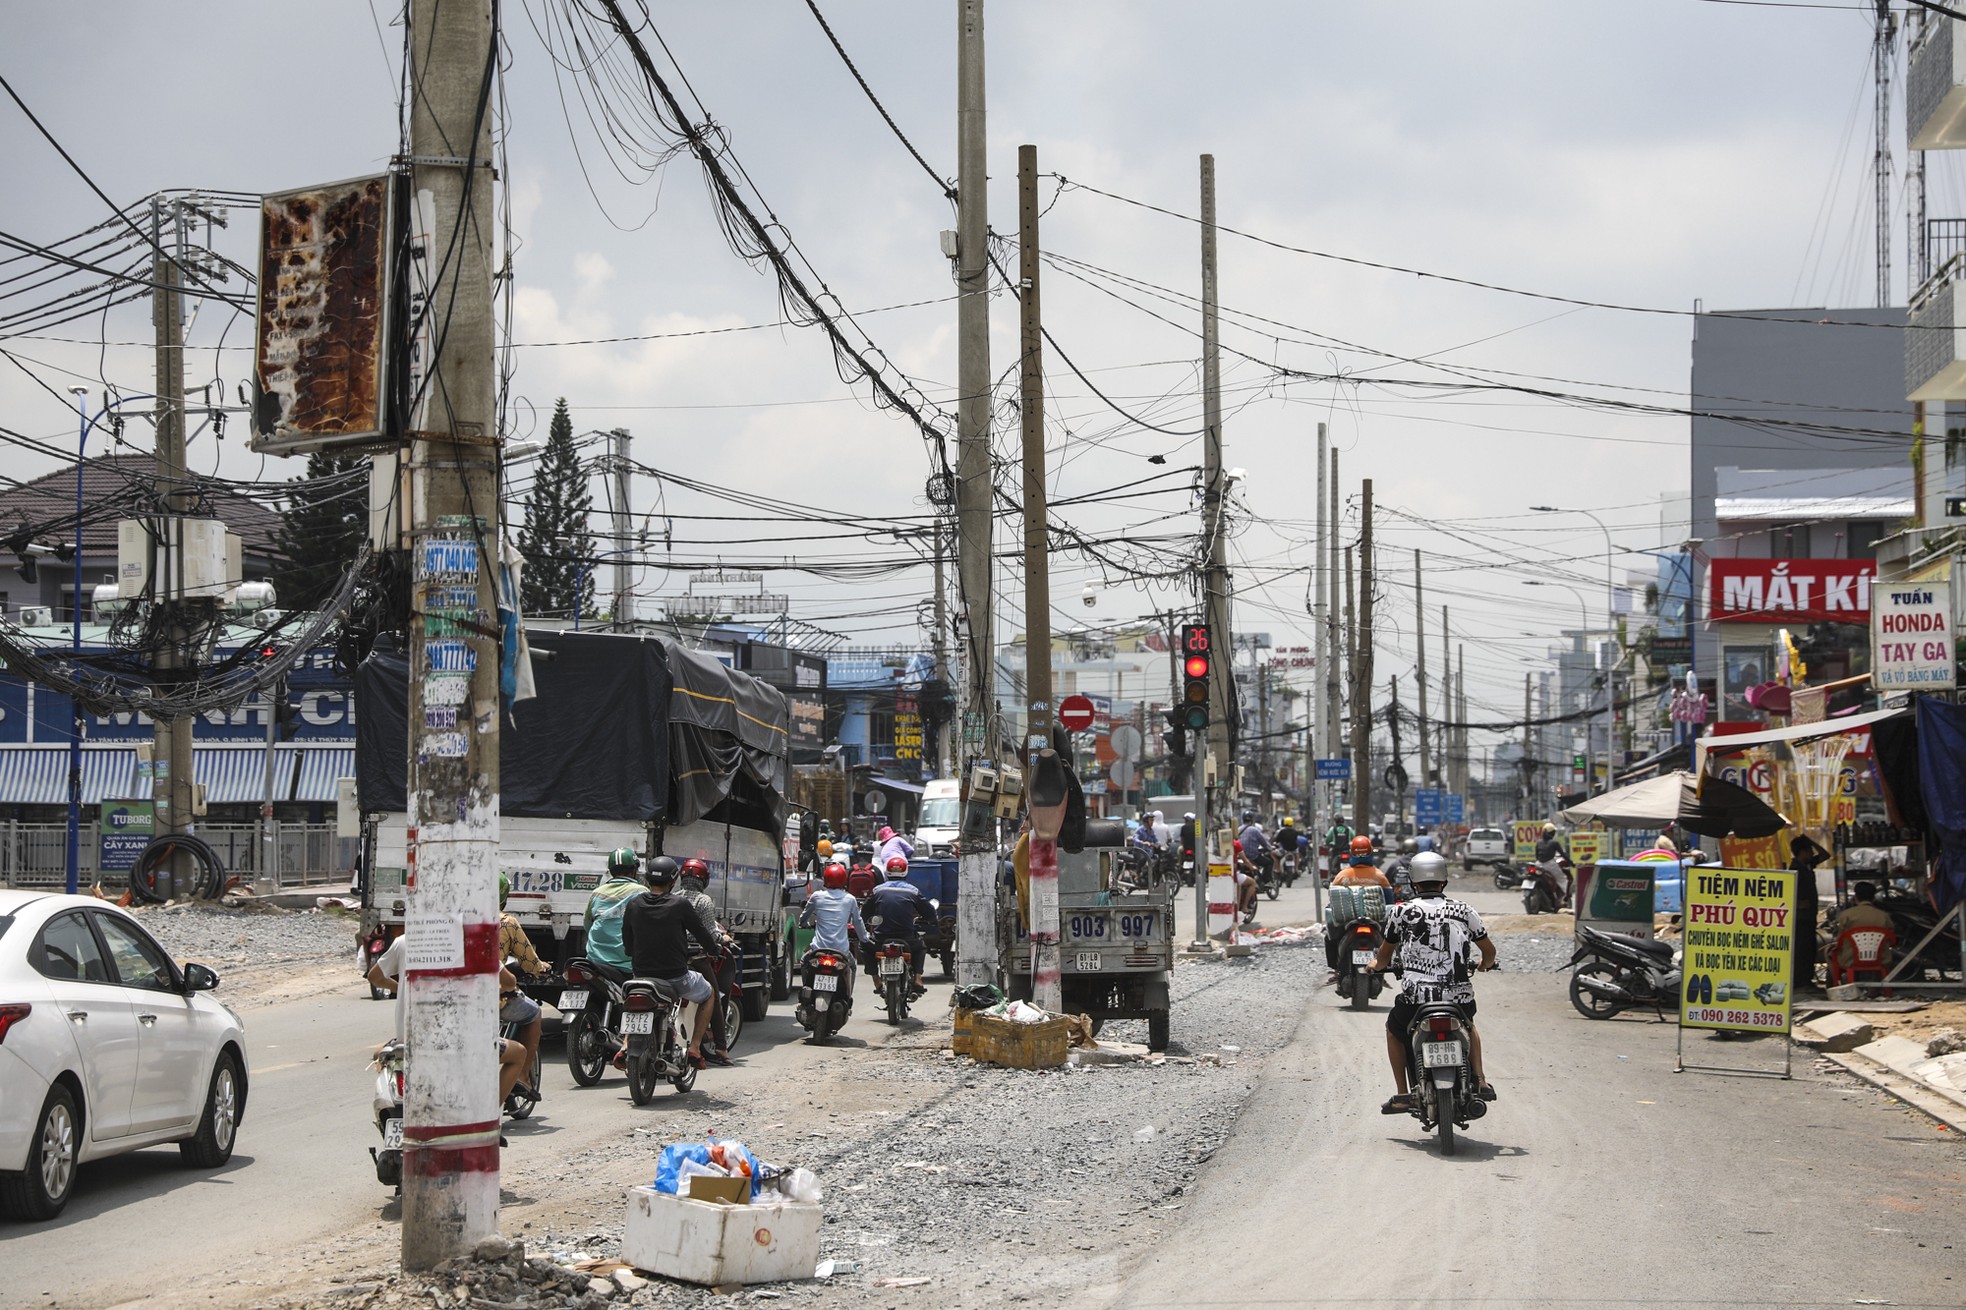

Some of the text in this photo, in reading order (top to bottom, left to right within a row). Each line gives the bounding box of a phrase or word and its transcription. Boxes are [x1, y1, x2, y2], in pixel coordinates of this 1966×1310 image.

[1723, 562, 1878, 611] MẮT KÍ
[1891, 588, 1933, 605] TUẤN
[1882, 613, 1945, 633] HONDA
[1189, 628, 1208, 650] 26
[1881, 642, 1947, 662] TAY GA
[895, 736, 922, 747] LASER
[895, 748, 922, 759] CNC
[113, 814, 152, 825] TUBORG
[1614, 880, 1647, 890] Castrol
[1698, 874, 1783, 901] TIỆM NỆM
[1690, 900, 1789, 928] PHÚ QUÝ
[1072, 916, 1154, 938] 903 997
[1688, 928, 1790, 951] CHUYÊN BỌC NỆM GHẾ SALON
[1695, 950, 1780, 976] VÀ BỌC YÊN XE CÁC LOẠI
[625, 1013, 650, 1022] 52-F2
[1688, 1009, 1784, 1027] ĐT: 090 262 5378
[624, 1024, 648, 1033] 2945
[1428, 1042, 1456, 1054] 89-H6
